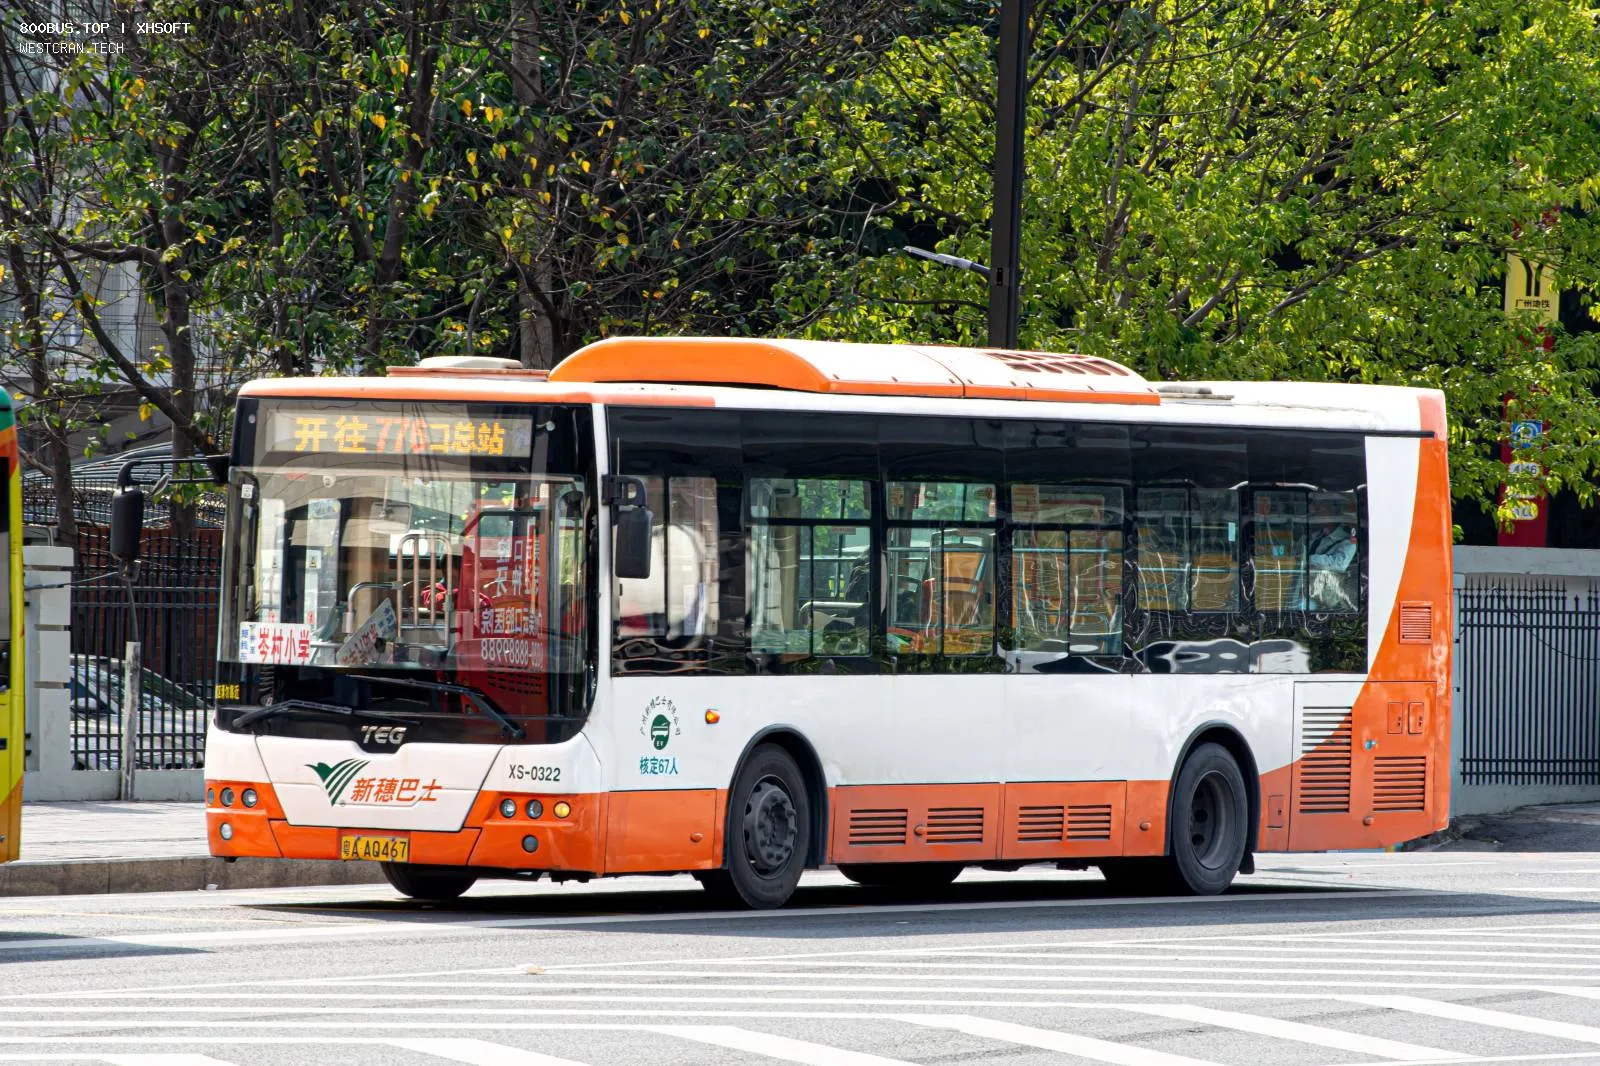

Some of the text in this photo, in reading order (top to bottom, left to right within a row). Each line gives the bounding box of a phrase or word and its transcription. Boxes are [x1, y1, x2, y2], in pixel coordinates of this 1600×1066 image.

[1515, 299, 1551, 308] 广州地铁
[257, 627, 310, 665] 岑村小学
[361, 725, 407, 745] TEG
[508, 764, 561, 782] XS-0322
[639, 756, 678, 775] 核定67人
[351, 777, 442, 802] 新穗巴士
